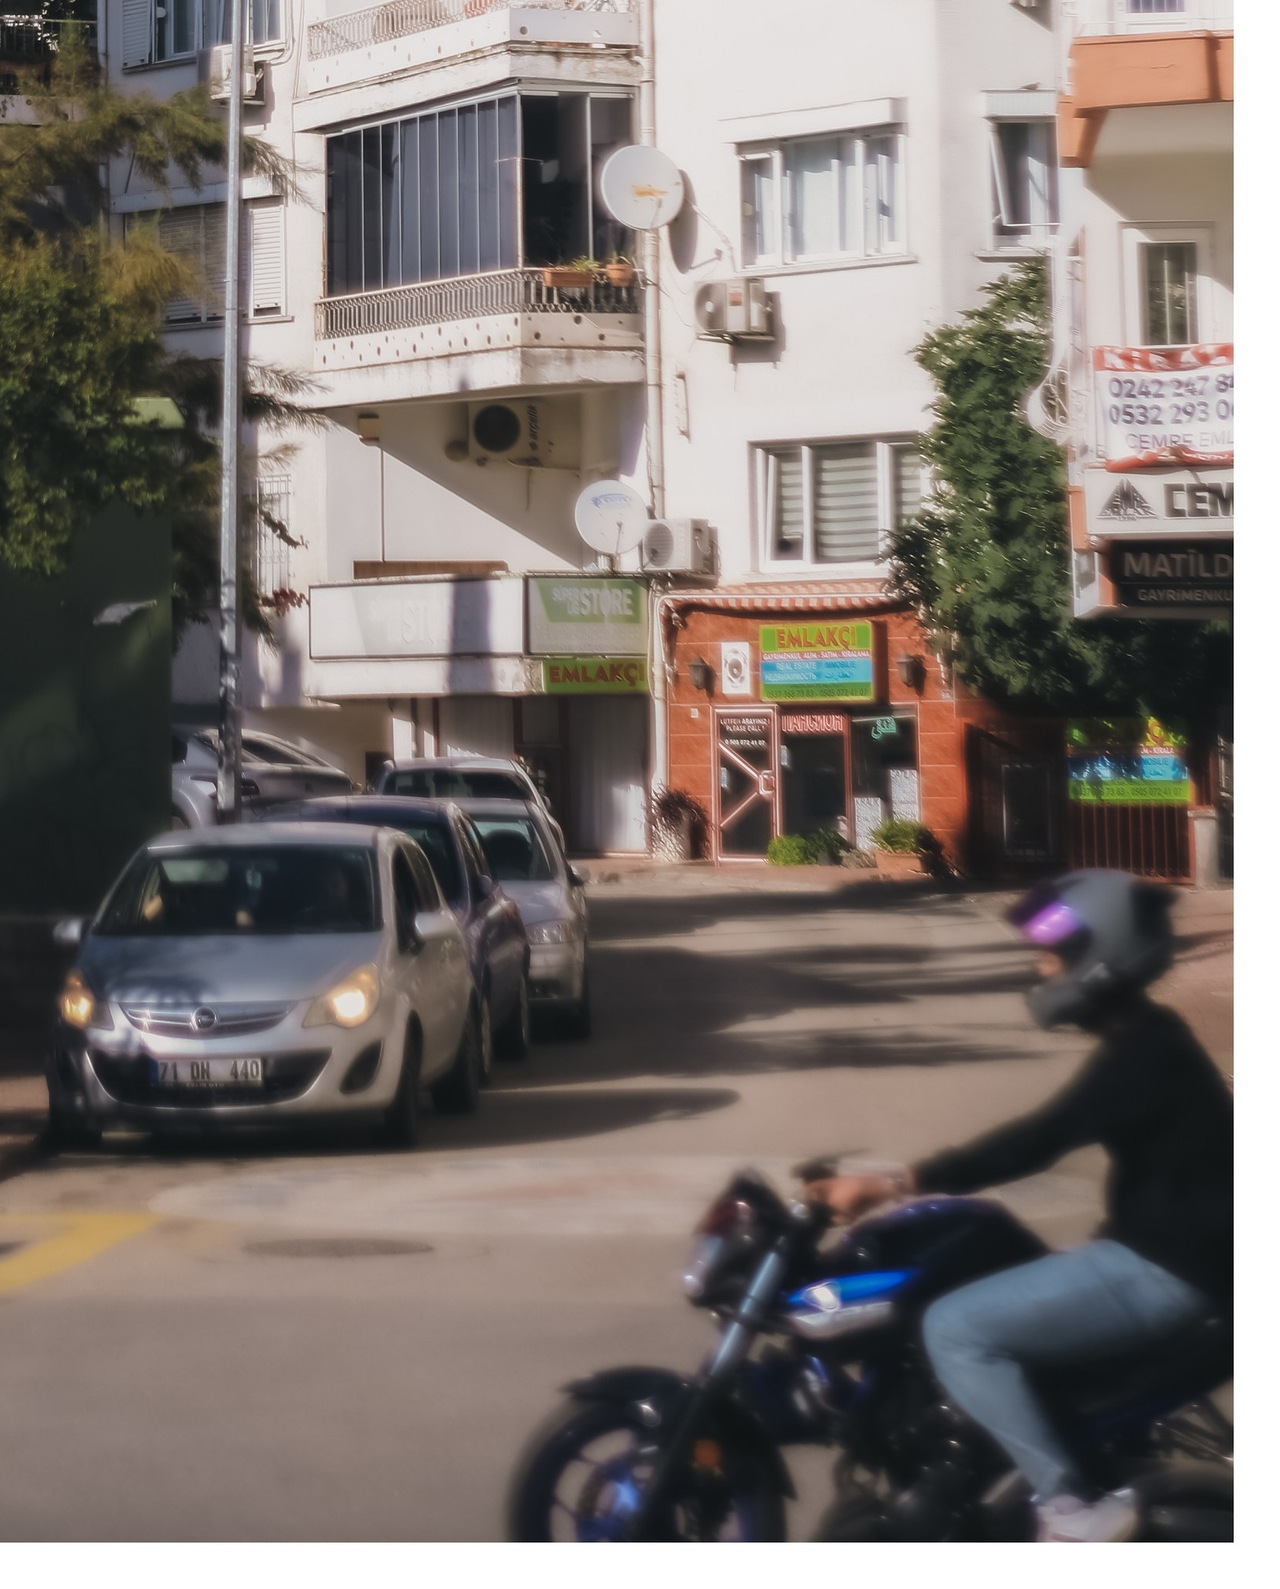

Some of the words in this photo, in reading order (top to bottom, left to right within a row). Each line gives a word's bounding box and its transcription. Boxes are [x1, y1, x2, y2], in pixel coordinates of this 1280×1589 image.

[1108, 377, 1166, 399] 0242
[1171, 375, 1210, 398] 247
[1108, 403, 1164, 425] 0532
[1169, 400, 1210, 424] 293
[1215, 398, 1233, 421] 0
[579, 587, 634, 616] STORE
[776, 625, 856, 651] EMLAKÇI
[549, 662, 645, 687] EMLAKÇI
[159, 1062, 178, 1081] 71
[230, 1060, 260, 1080] 440
